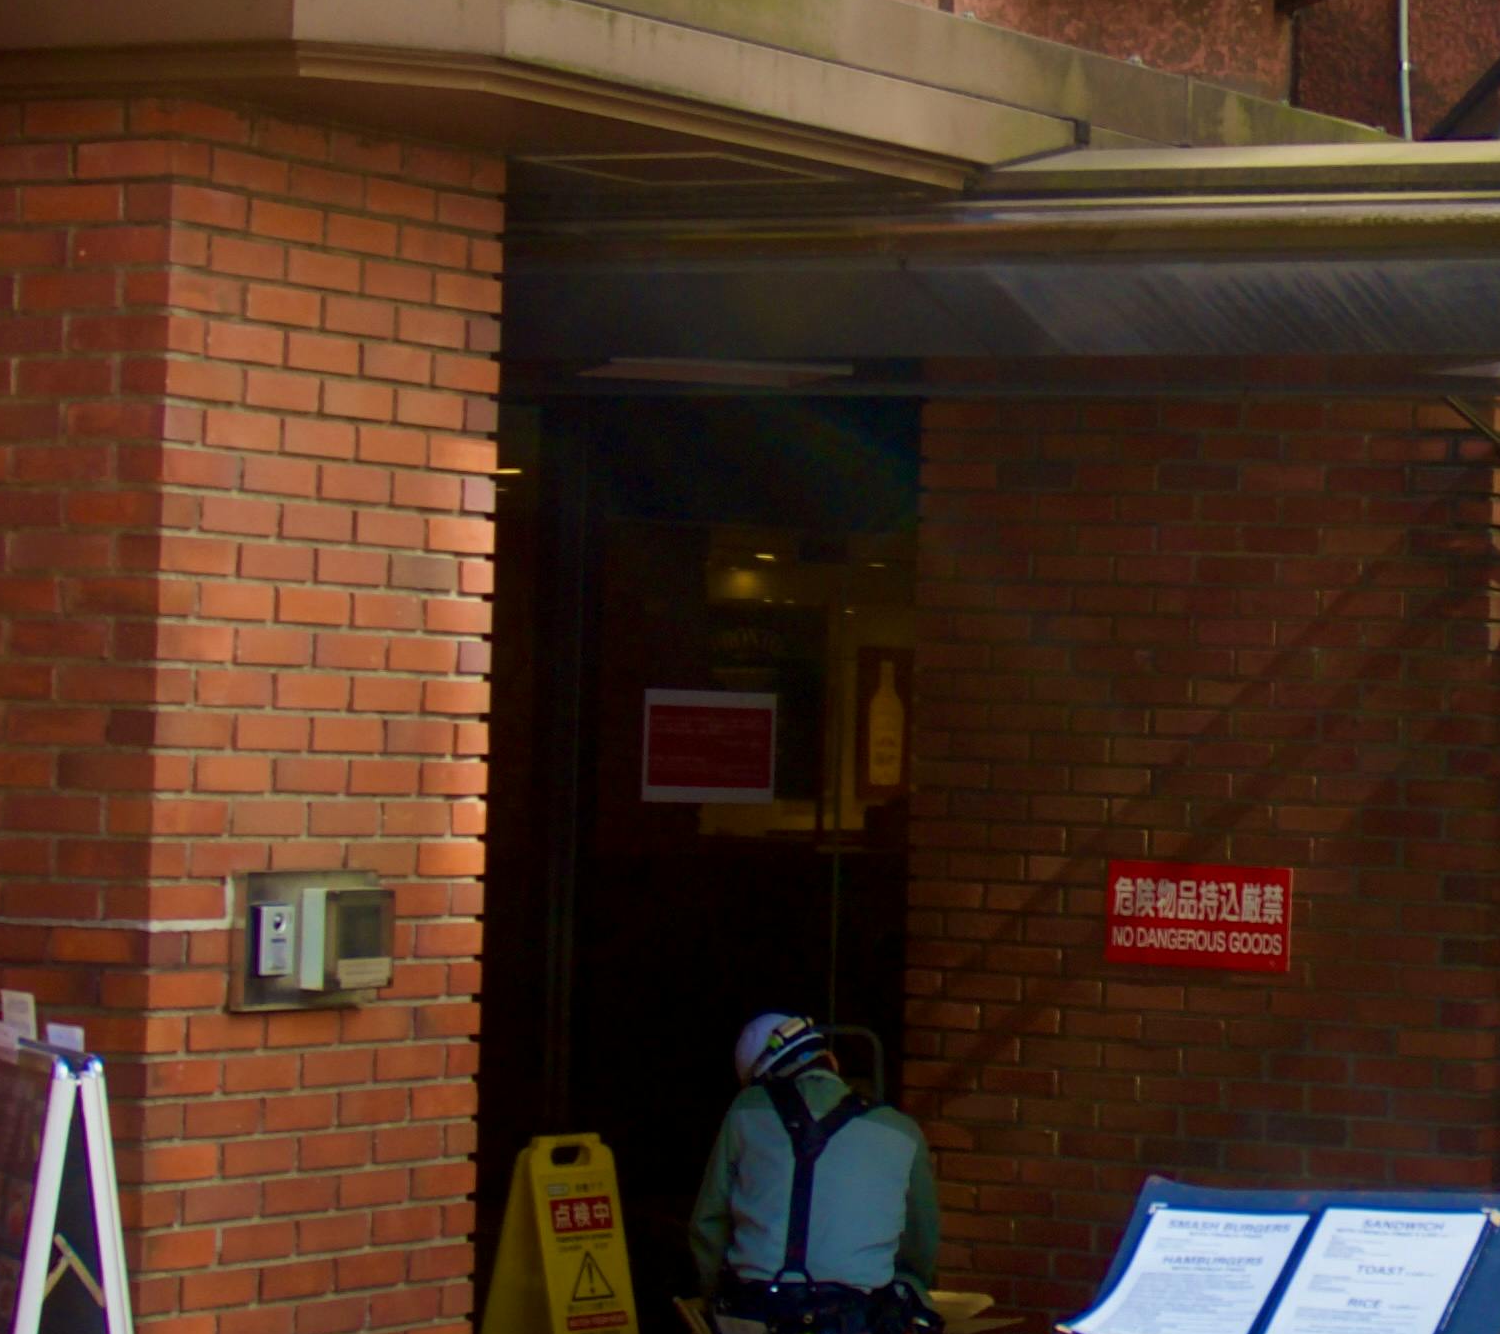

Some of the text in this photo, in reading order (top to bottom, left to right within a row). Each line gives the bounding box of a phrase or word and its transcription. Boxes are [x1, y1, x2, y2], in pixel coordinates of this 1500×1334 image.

[1113, 876, 1284, 924] 危険物品持込厳禁
[1112, 926, 1282, 956] NO DANGEROUS GOODS
[554, 1201, 611, 1228] 点検中
[1168, 1219, 1291, 1234] SMASH BURGERS
[1363, 1219, 1445, 1231] SANDWICH
[1162, 1255, 1264, 1266] HAMBURGERS
[1357, 1264, 1404, 1275] TOAST
[1347, 1298, 1382, 1308] RICE
